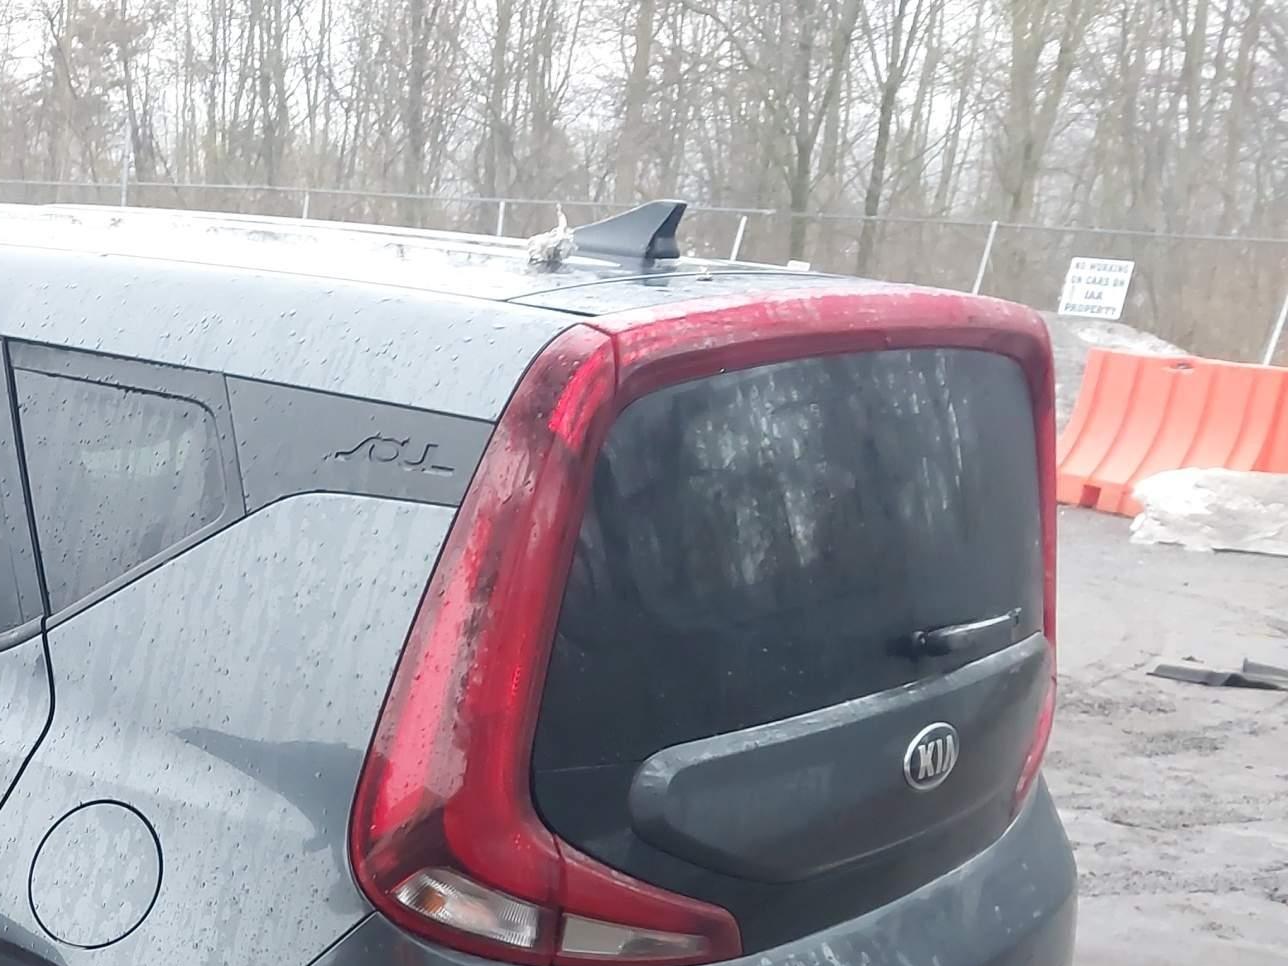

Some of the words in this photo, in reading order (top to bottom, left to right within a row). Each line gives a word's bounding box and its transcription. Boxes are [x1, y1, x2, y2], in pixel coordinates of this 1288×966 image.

[1090, 262, 1129, 273] WORKING
[1085, 276, 1110, 287] CARS
[1084, 289, 1103, 300] IAA
[1064, 302, 1117, 316] PROPERTY
[917, 734, 956, 780] KIA
